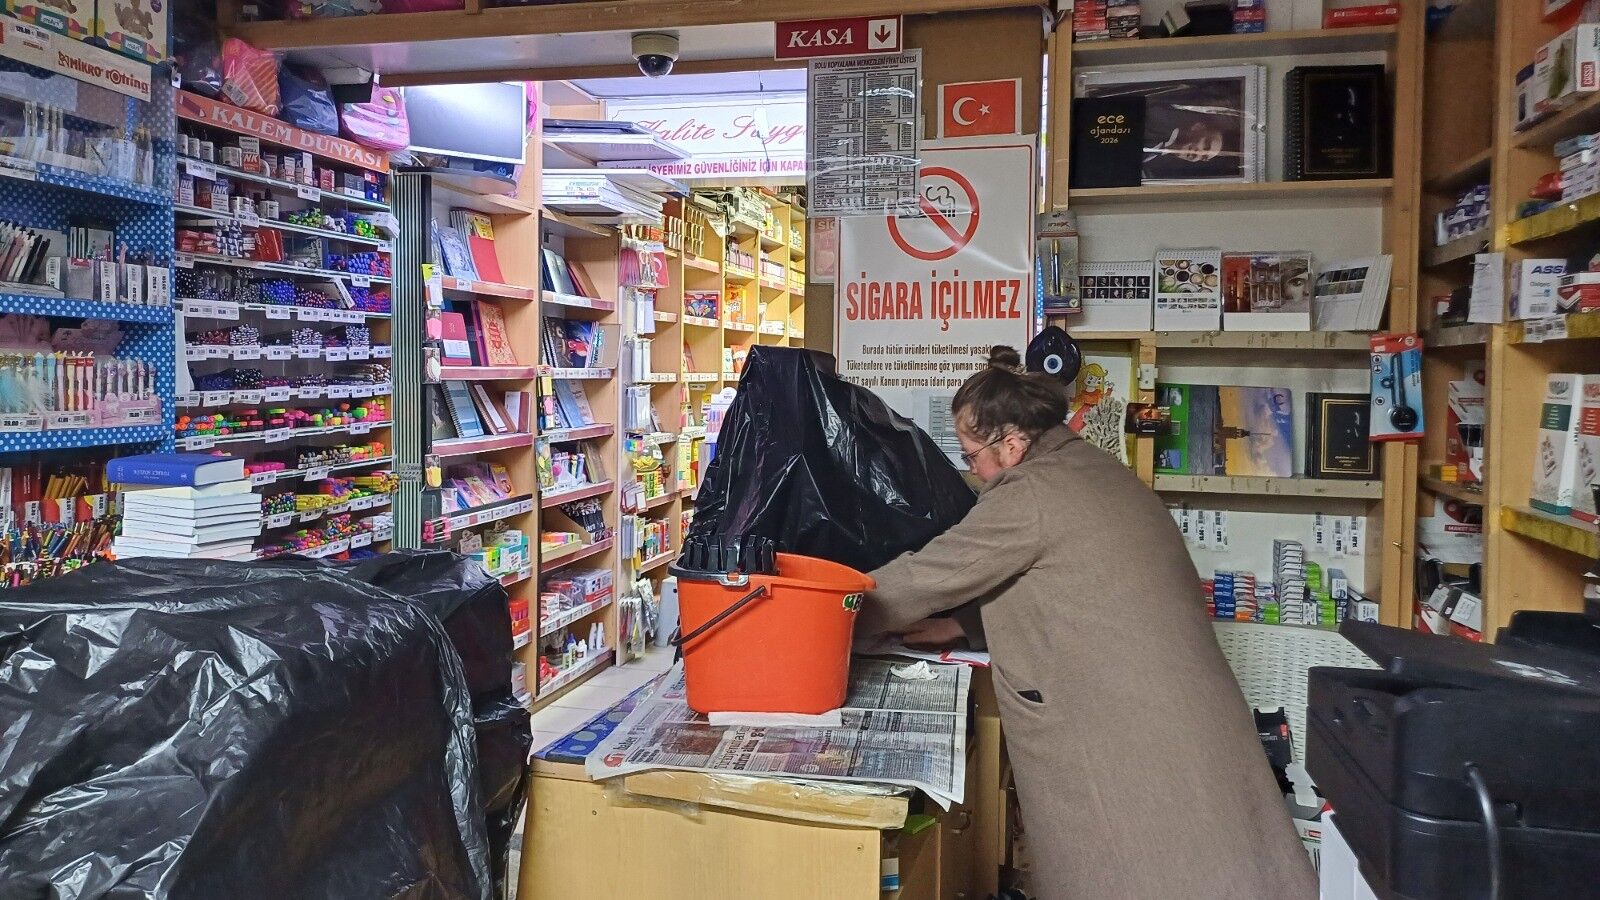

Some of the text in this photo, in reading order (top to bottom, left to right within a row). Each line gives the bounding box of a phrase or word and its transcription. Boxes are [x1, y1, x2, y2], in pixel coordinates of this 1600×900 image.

[787, 28, 853, 48] KASA
[1097, 114, 1125, 124] ece
[211, 105, 382, 168] KALEM DÜNYASI
[1090, 125, 1131, 138] ajandası
[694, 158, 757, 175] GÜVENLİĞİNİZ
[846, 269, 1021, 331] SİGARA İÇİLMEZ
[862, 344, 884, 355] Burada
[885, 344, 903, 355] tütün
[904, 344, 930, 355] ürünleri
[931, 344, 969, 355] tüketilmesi
[846, 360, 883, 371] Tüketenlere
[884, 362, 892, 371] ve
[893, 360, 938, 371] tüketilmesine
[939, 361, 950, 374] göz
[951, 362, 973, 374] yuman
[861, 376, 879, 388] sayılı
[880, 376, 900, 387] Kanun
[900, 376, 928, 389] uyarınca
[929, 376, 946, 387] idari
[946, 379, 962, 389] para
